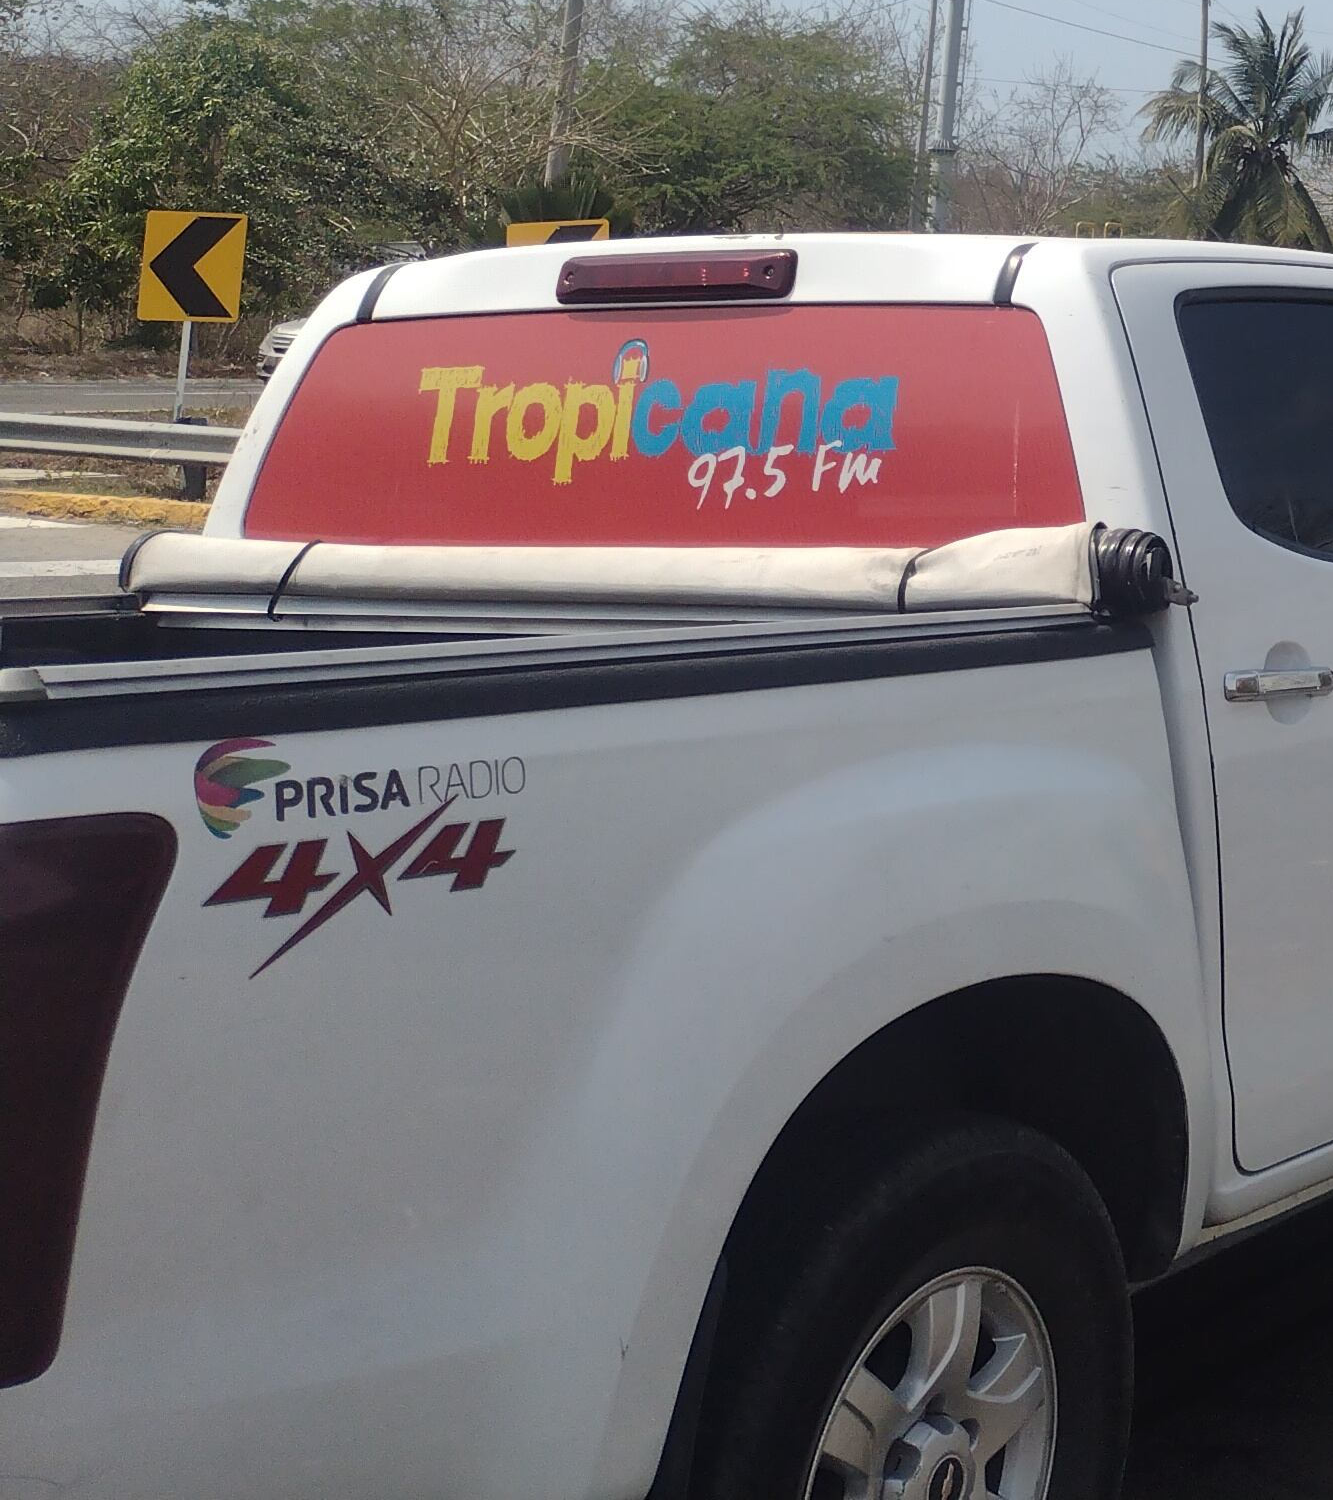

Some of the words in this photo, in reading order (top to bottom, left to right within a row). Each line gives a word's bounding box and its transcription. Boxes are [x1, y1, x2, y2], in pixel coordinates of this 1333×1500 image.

[418, 357, 899, 485] Tropicana
[687, 444, 796, 510] 97.5
[274, 768, 411, 822] PRISA
[418, 756, 526, 806] RADIO
